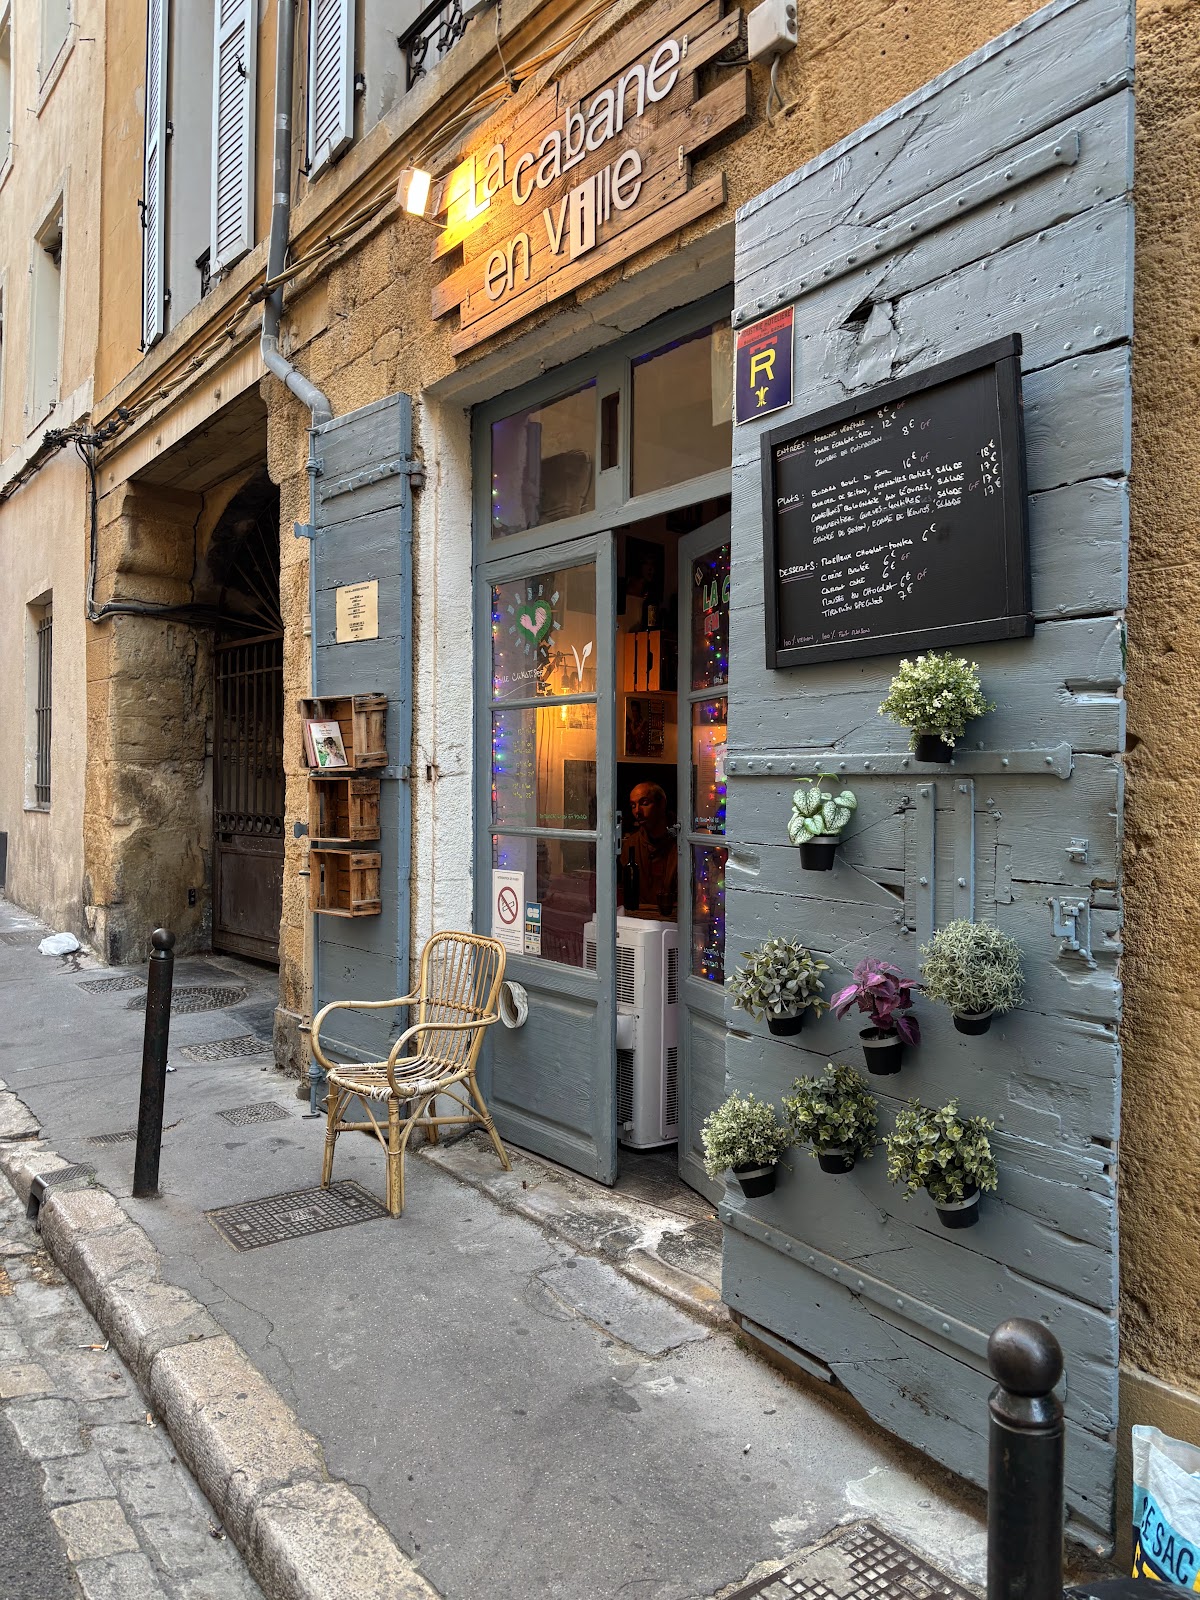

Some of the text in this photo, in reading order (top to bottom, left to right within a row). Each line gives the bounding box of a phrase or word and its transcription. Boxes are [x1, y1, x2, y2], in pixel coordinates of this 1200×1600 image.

[466, 40, 681, 222] La cabane
[484, 232, 530, 301] en
[750, 348, 776, 388] R
[1153, 1522, 1194, 1585] SAC
